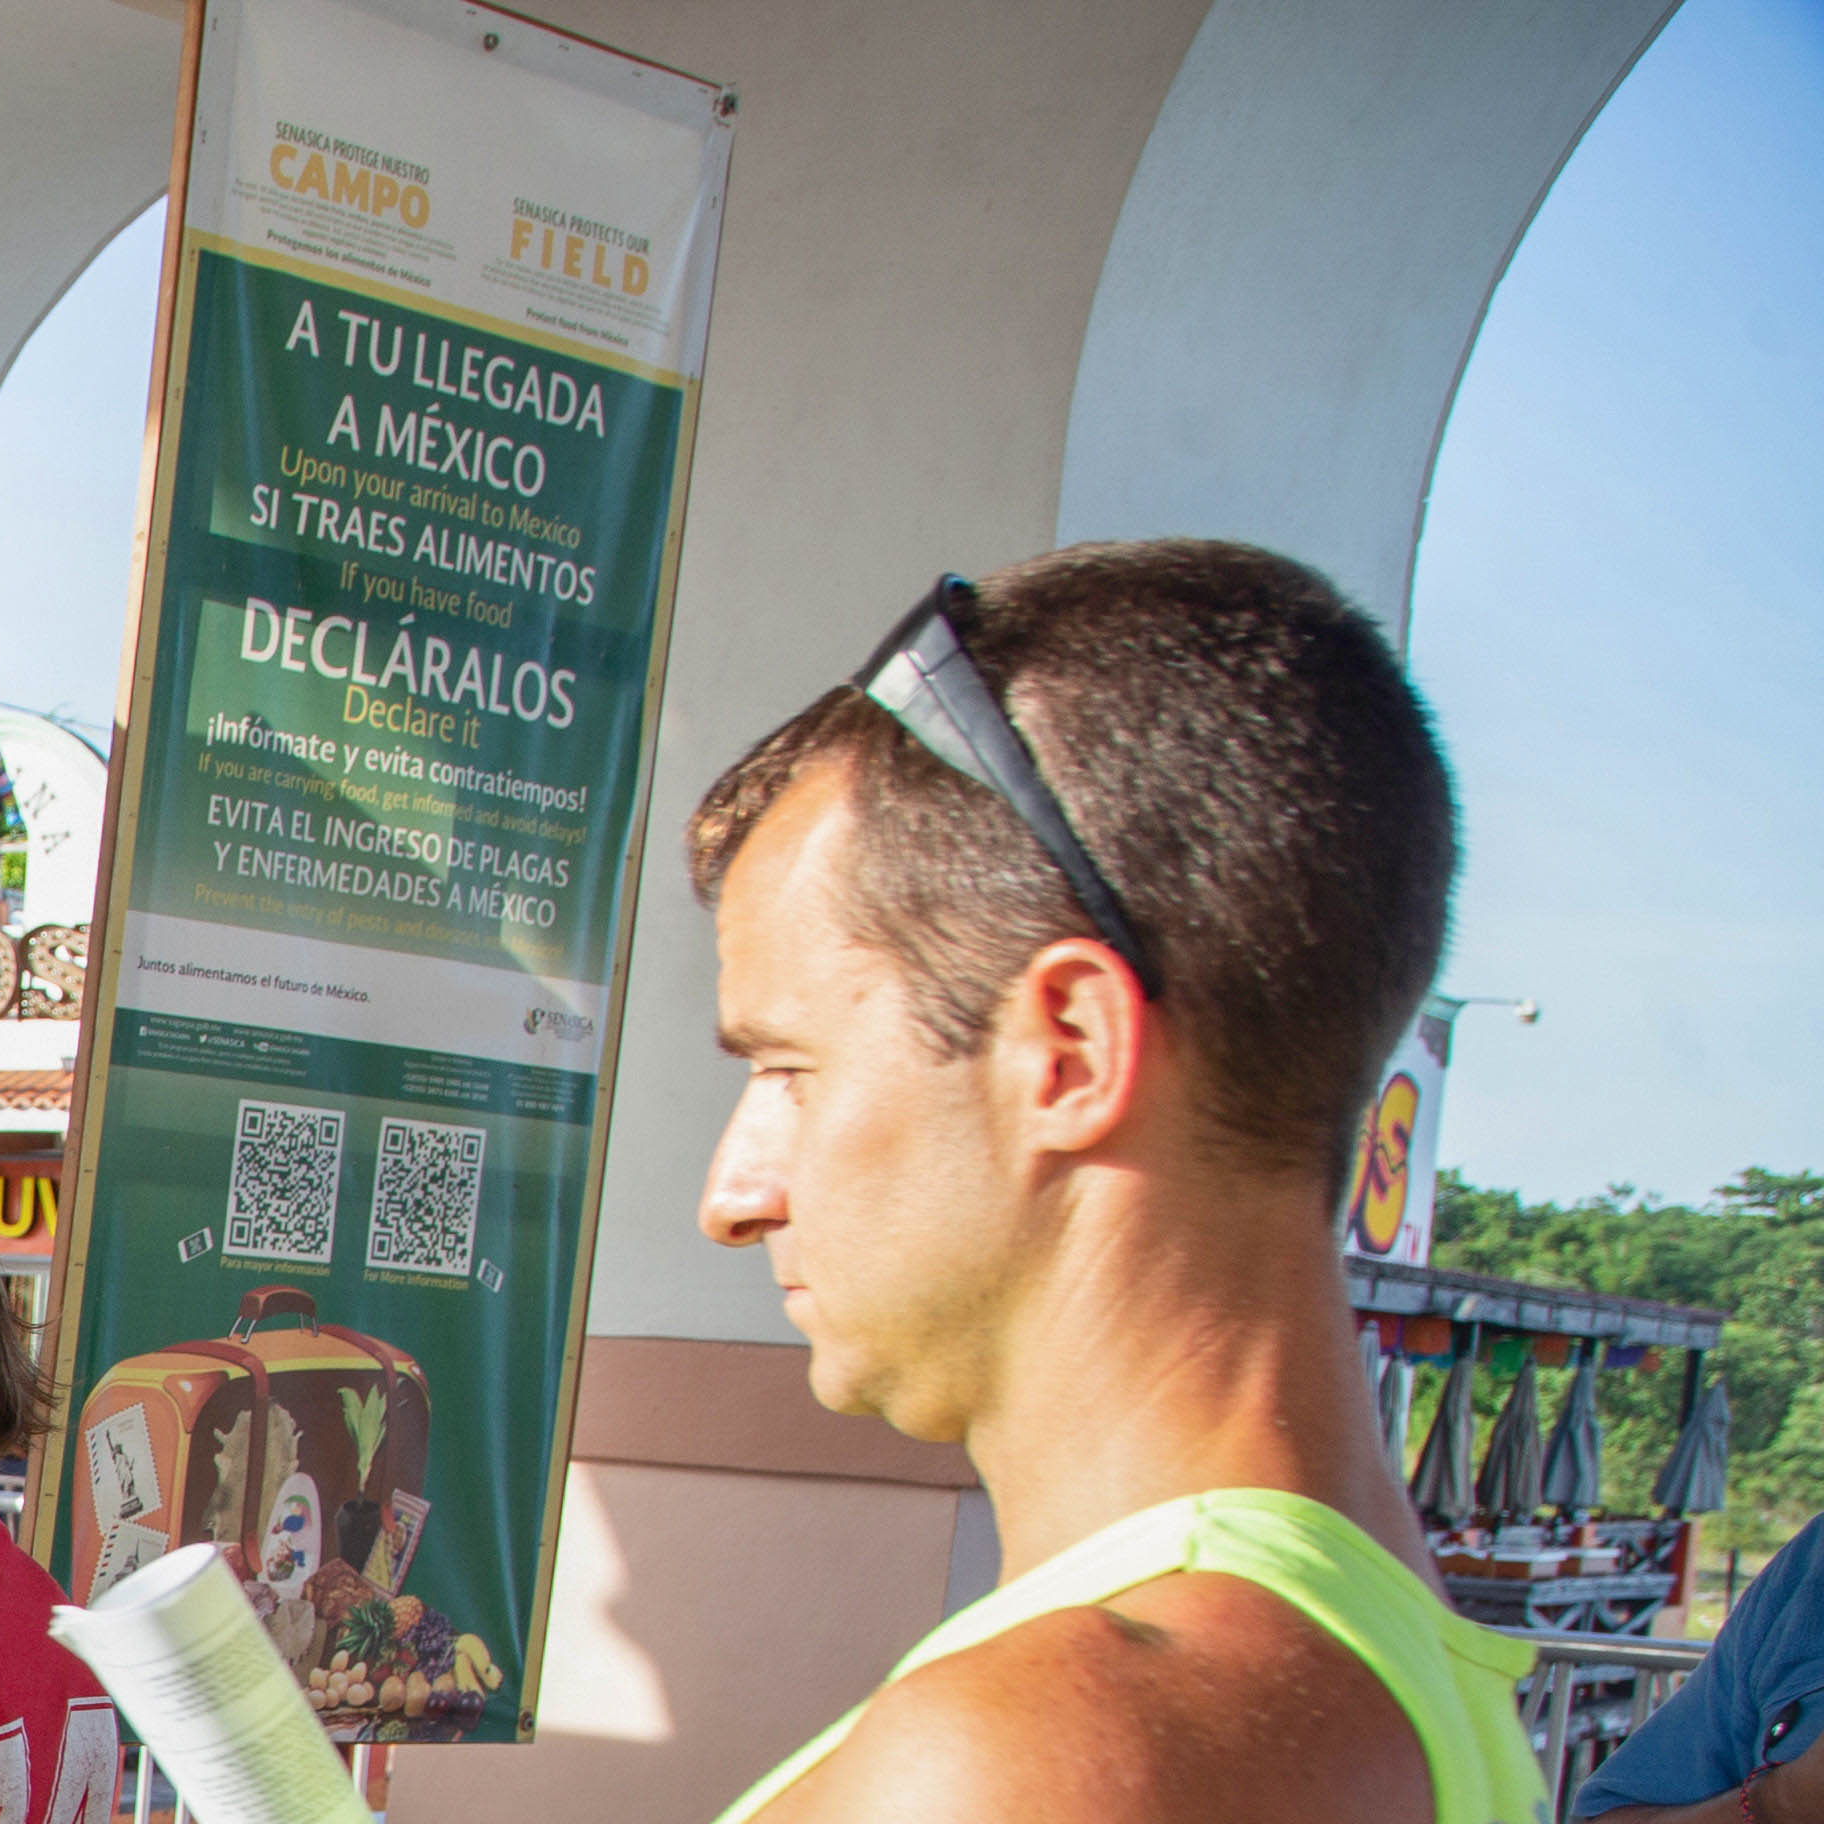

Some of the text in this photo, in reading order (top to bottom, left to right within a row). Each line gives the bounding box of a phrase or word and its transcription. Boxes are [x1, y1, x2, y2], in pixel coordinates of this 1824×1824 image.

[269, 142, 432, 229] CAMPO
[275, 120, 430, 186] SENASICA PROTEGE NUESTRO
[509, 217, 650, 297] FIELD
[512, 196, 651, 256] SENASICA PROTECTS OUR
[285, 299, 605, 439] A TU LLEGADA
[326, 393, 546, 498] A MÉXICO
[279, 445, 582, 550] Upon your arrival to Mexico
[249, 483, 597, 606] SI TRAES ALIMENTOS
[340, 559, 514, 630] If you have food
[239, 597, 577, 731] DECLÁRALOS
[342, 684, 481, 750] Declare it
[198, 751, 212, 773] If
[215, 760, 245, 780] you
[247, 765, 271, 785] are
[273, 770, 337, 801] carrying
[381, 790, 409, 812] get
[412, 793, 474, 821] informed
[205, 712, 588, 814] ¡Infórmate y evita contratiempos!
[206, 794, 570, 889] EVITA EL INGRESO DE PLAGAS
[213, 840, 557, 929] Y ENFERMEDADES A MÉXICO
[136, 955, 176, 975] Juntos
[177, 962, 257, 986] alimentamos
[260, 975, 272, 988] el
[273, 975, 309, 993] futuro
[310, 984, 324, 997] de
[219, 1256, 244, 1269] Para
[244, 1260, 274, 1275] mayor
